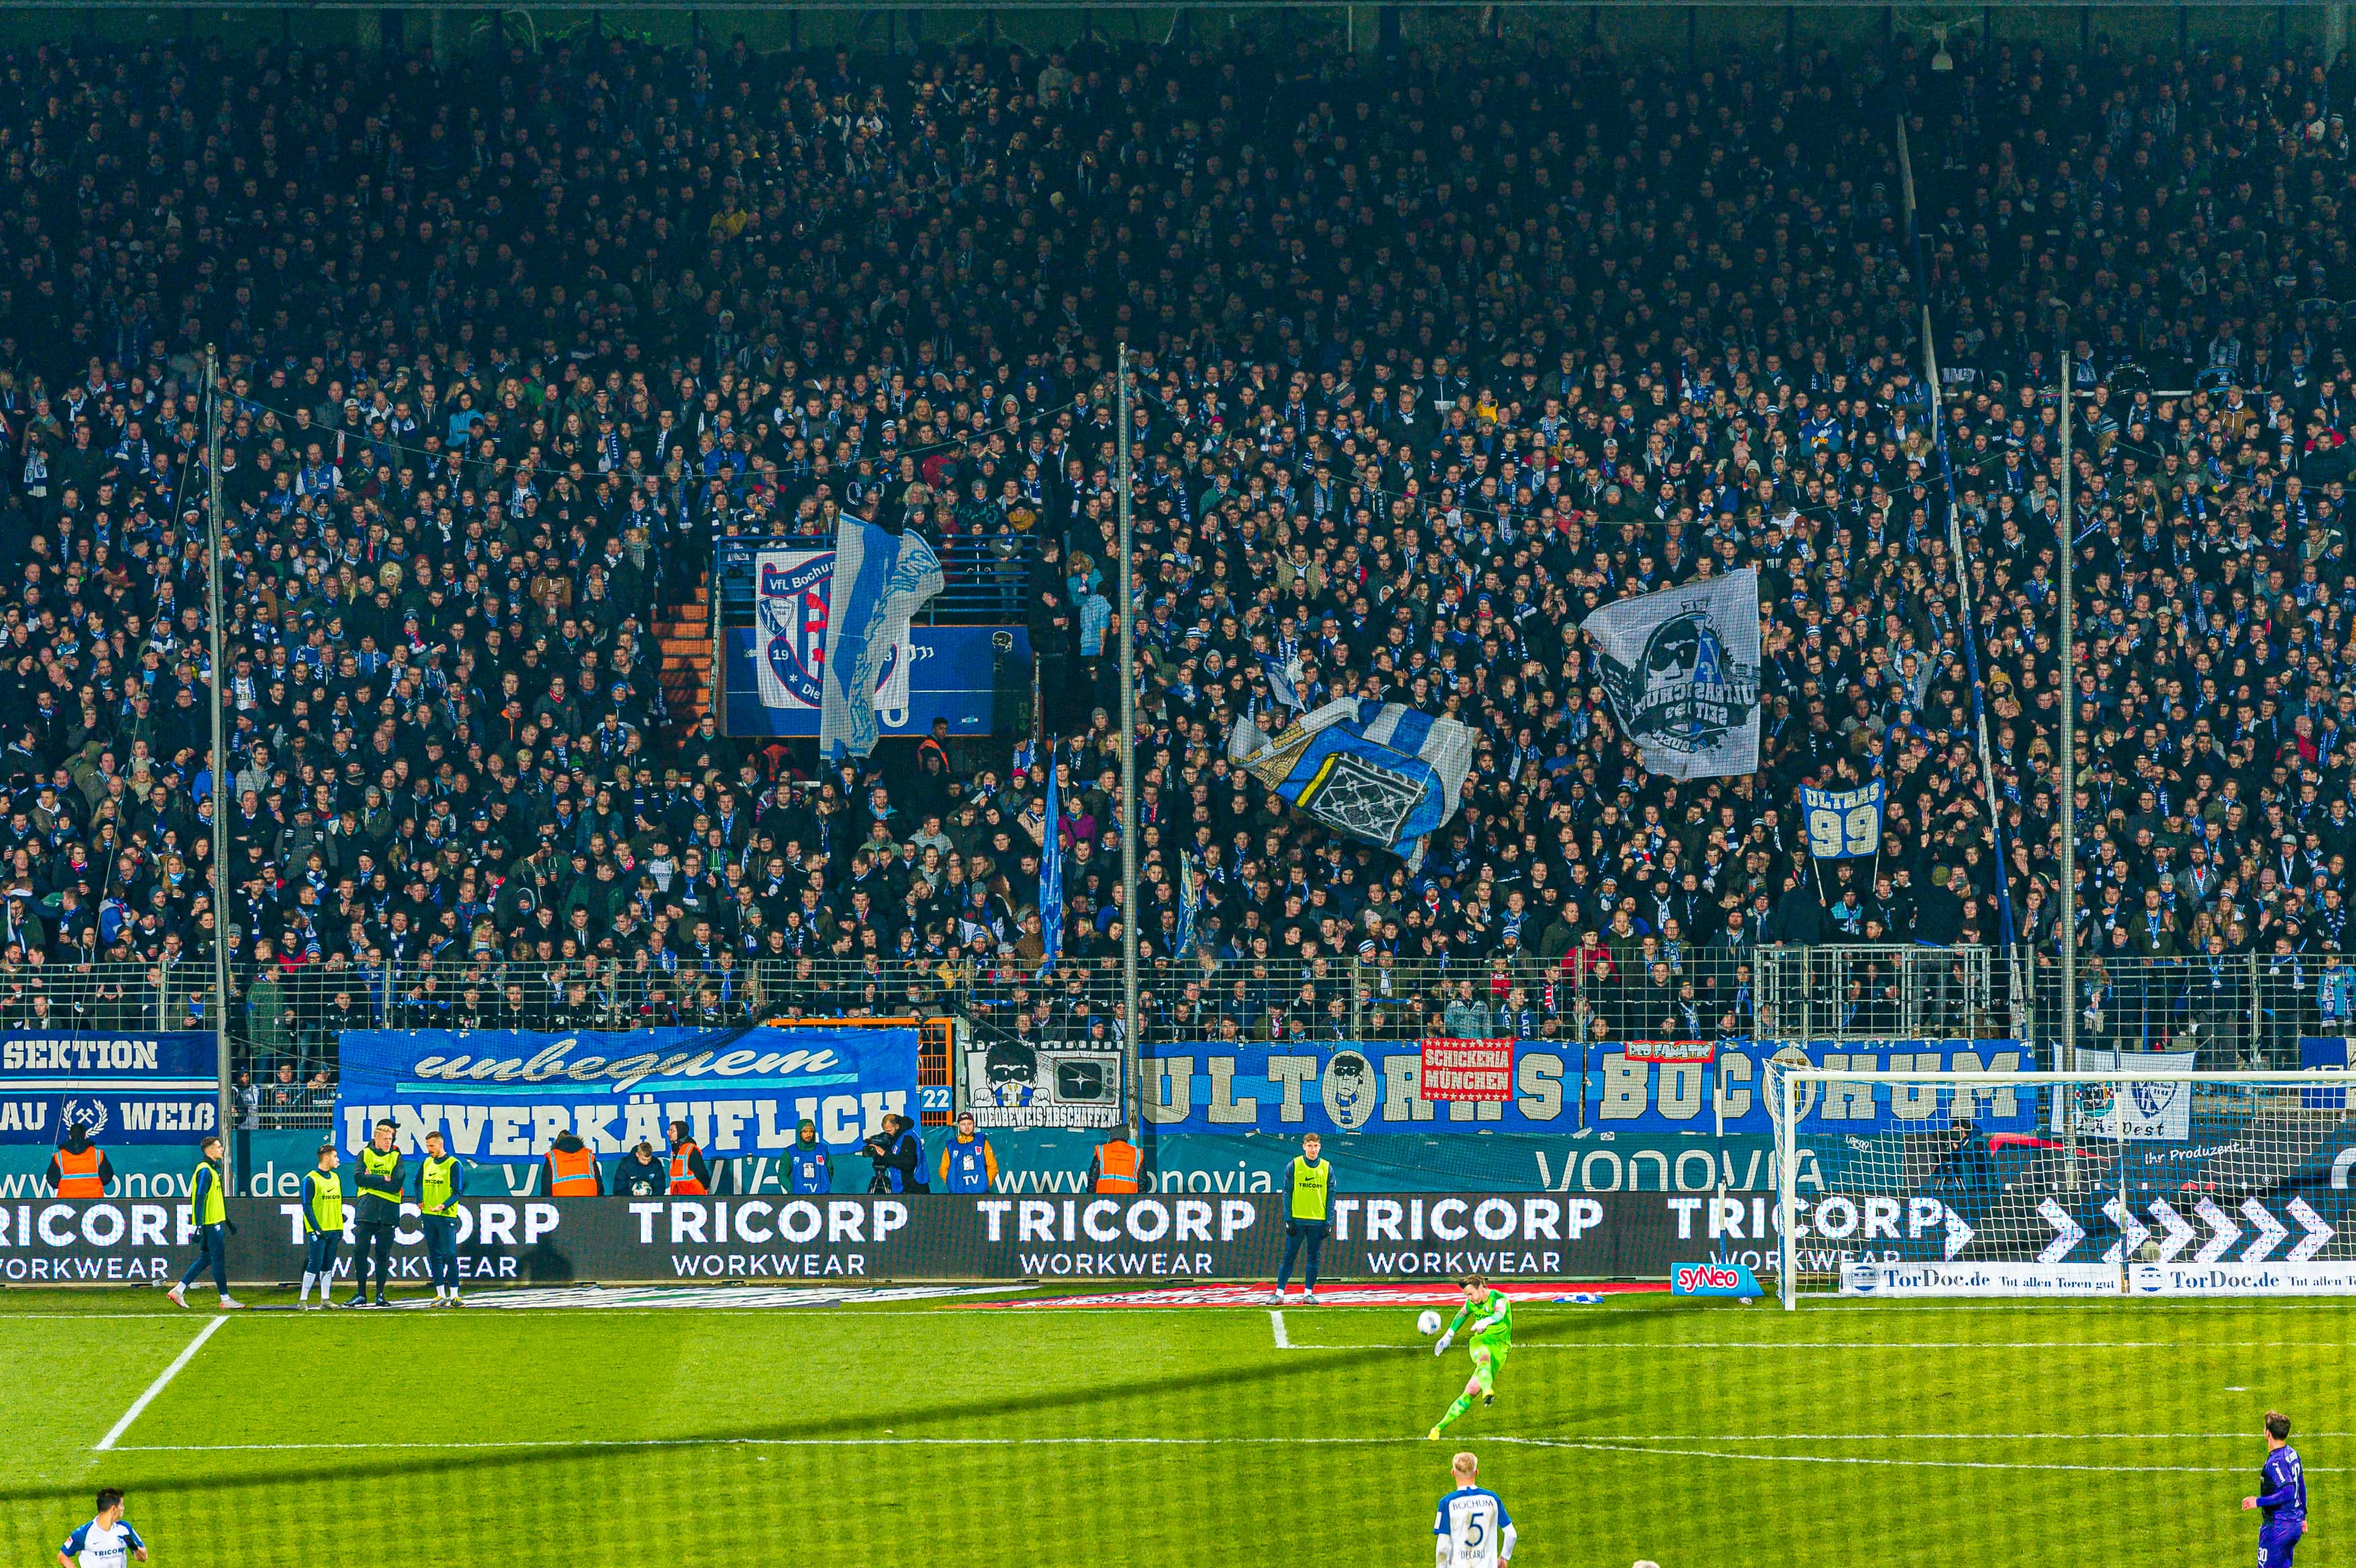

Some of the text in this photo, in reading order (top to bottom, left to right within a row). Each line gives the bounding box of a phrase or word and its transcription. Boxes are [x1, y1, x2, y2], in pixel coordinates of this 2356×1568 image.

[769, 579, 790, 590] VfL
[773, 649, 789, 661] 19
[801, 682, 821, 699] Die
[1805, 782, 1880, 810] ULTRAS
[1810, 804, 1879, 857] 99
[3, 1040, 158, 1069] SEKTION
[1425, 1048, 1509, 1067] SCHICKERIA
[415, 1038, 839, 1094] unbequem
[1425, 1067, 1509, 1090] MÜNCHEN
[922, 1090, 950, 1108] 22
[344, 1090, 907, 1156] UNVERKÄUFLICH
[2145, 1151, 2166, 1165] Ihr
[963, 1175, 979, 1185] TV
[628, 1201, 908, 1244] TRICORP
[977, 1200, 1255, 1242] TRICORP
[1333, 1199, 1603, 1241] TRICORP
[1667, 1197, 1943, 1239] TRICORP
[0, 1257, 169, 1279] ORKWEAR
[672, 1254, 865, 1276] WORKWEAR
[1020, 1253, 1213, 1275] WORKWEAR
[1367, 1252, 1560, 1274] WORKWEAR
[1678, 1266, 1739, 1293] syNeo
[1884, 1270, 1990, 1288] TorDoc.de
[2023, 1277, 2051, 1287] allen
[2056, 1278, 2091, 1288] Toren
[2095, 1281, 2115, 1290] gut
[2170, 1271, 2279, 1288] TorDoc.de
[2313, 1276, 2342, 1286] allen
[1453, 1499, 1494, 1511] BOCHUM
[1464, 1512, 1484, 1547] 5
